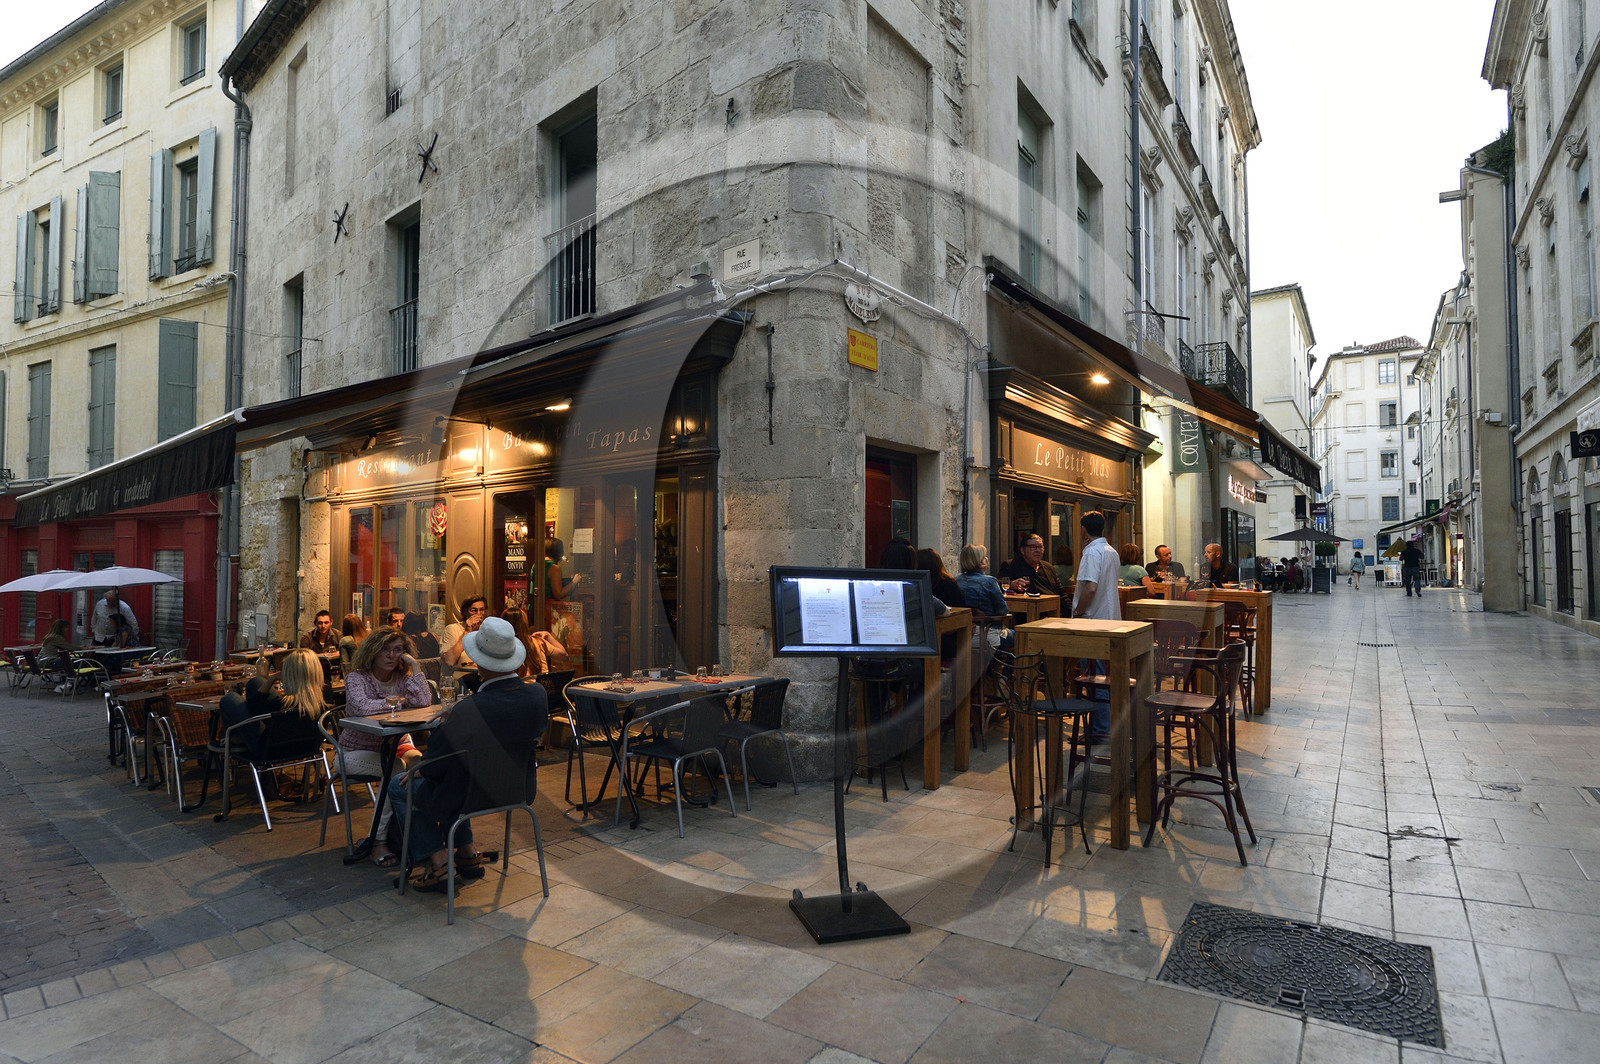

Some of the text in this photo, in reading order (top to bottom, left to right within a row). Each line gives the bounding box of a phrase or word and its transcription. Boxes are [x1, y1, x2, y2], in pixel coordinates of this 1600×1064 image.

[731, 259, 752, 273] FRESQUE
[736, 248, 746, 259] RUE
[502, 430, 531, 450] Bar
[555, 418, 581, 440] vin
[586, 426, 652, 452] Tapas
[357, 448, 433, 479] Restrant
[1034, 442, 1109, 478] Le Petit Mas
[39, 499, 50, 522] Le
[53, 493, 72, 518] Petit
[75, 487, 99, 513] Mas
[508, 548, 524, 556] MANO
